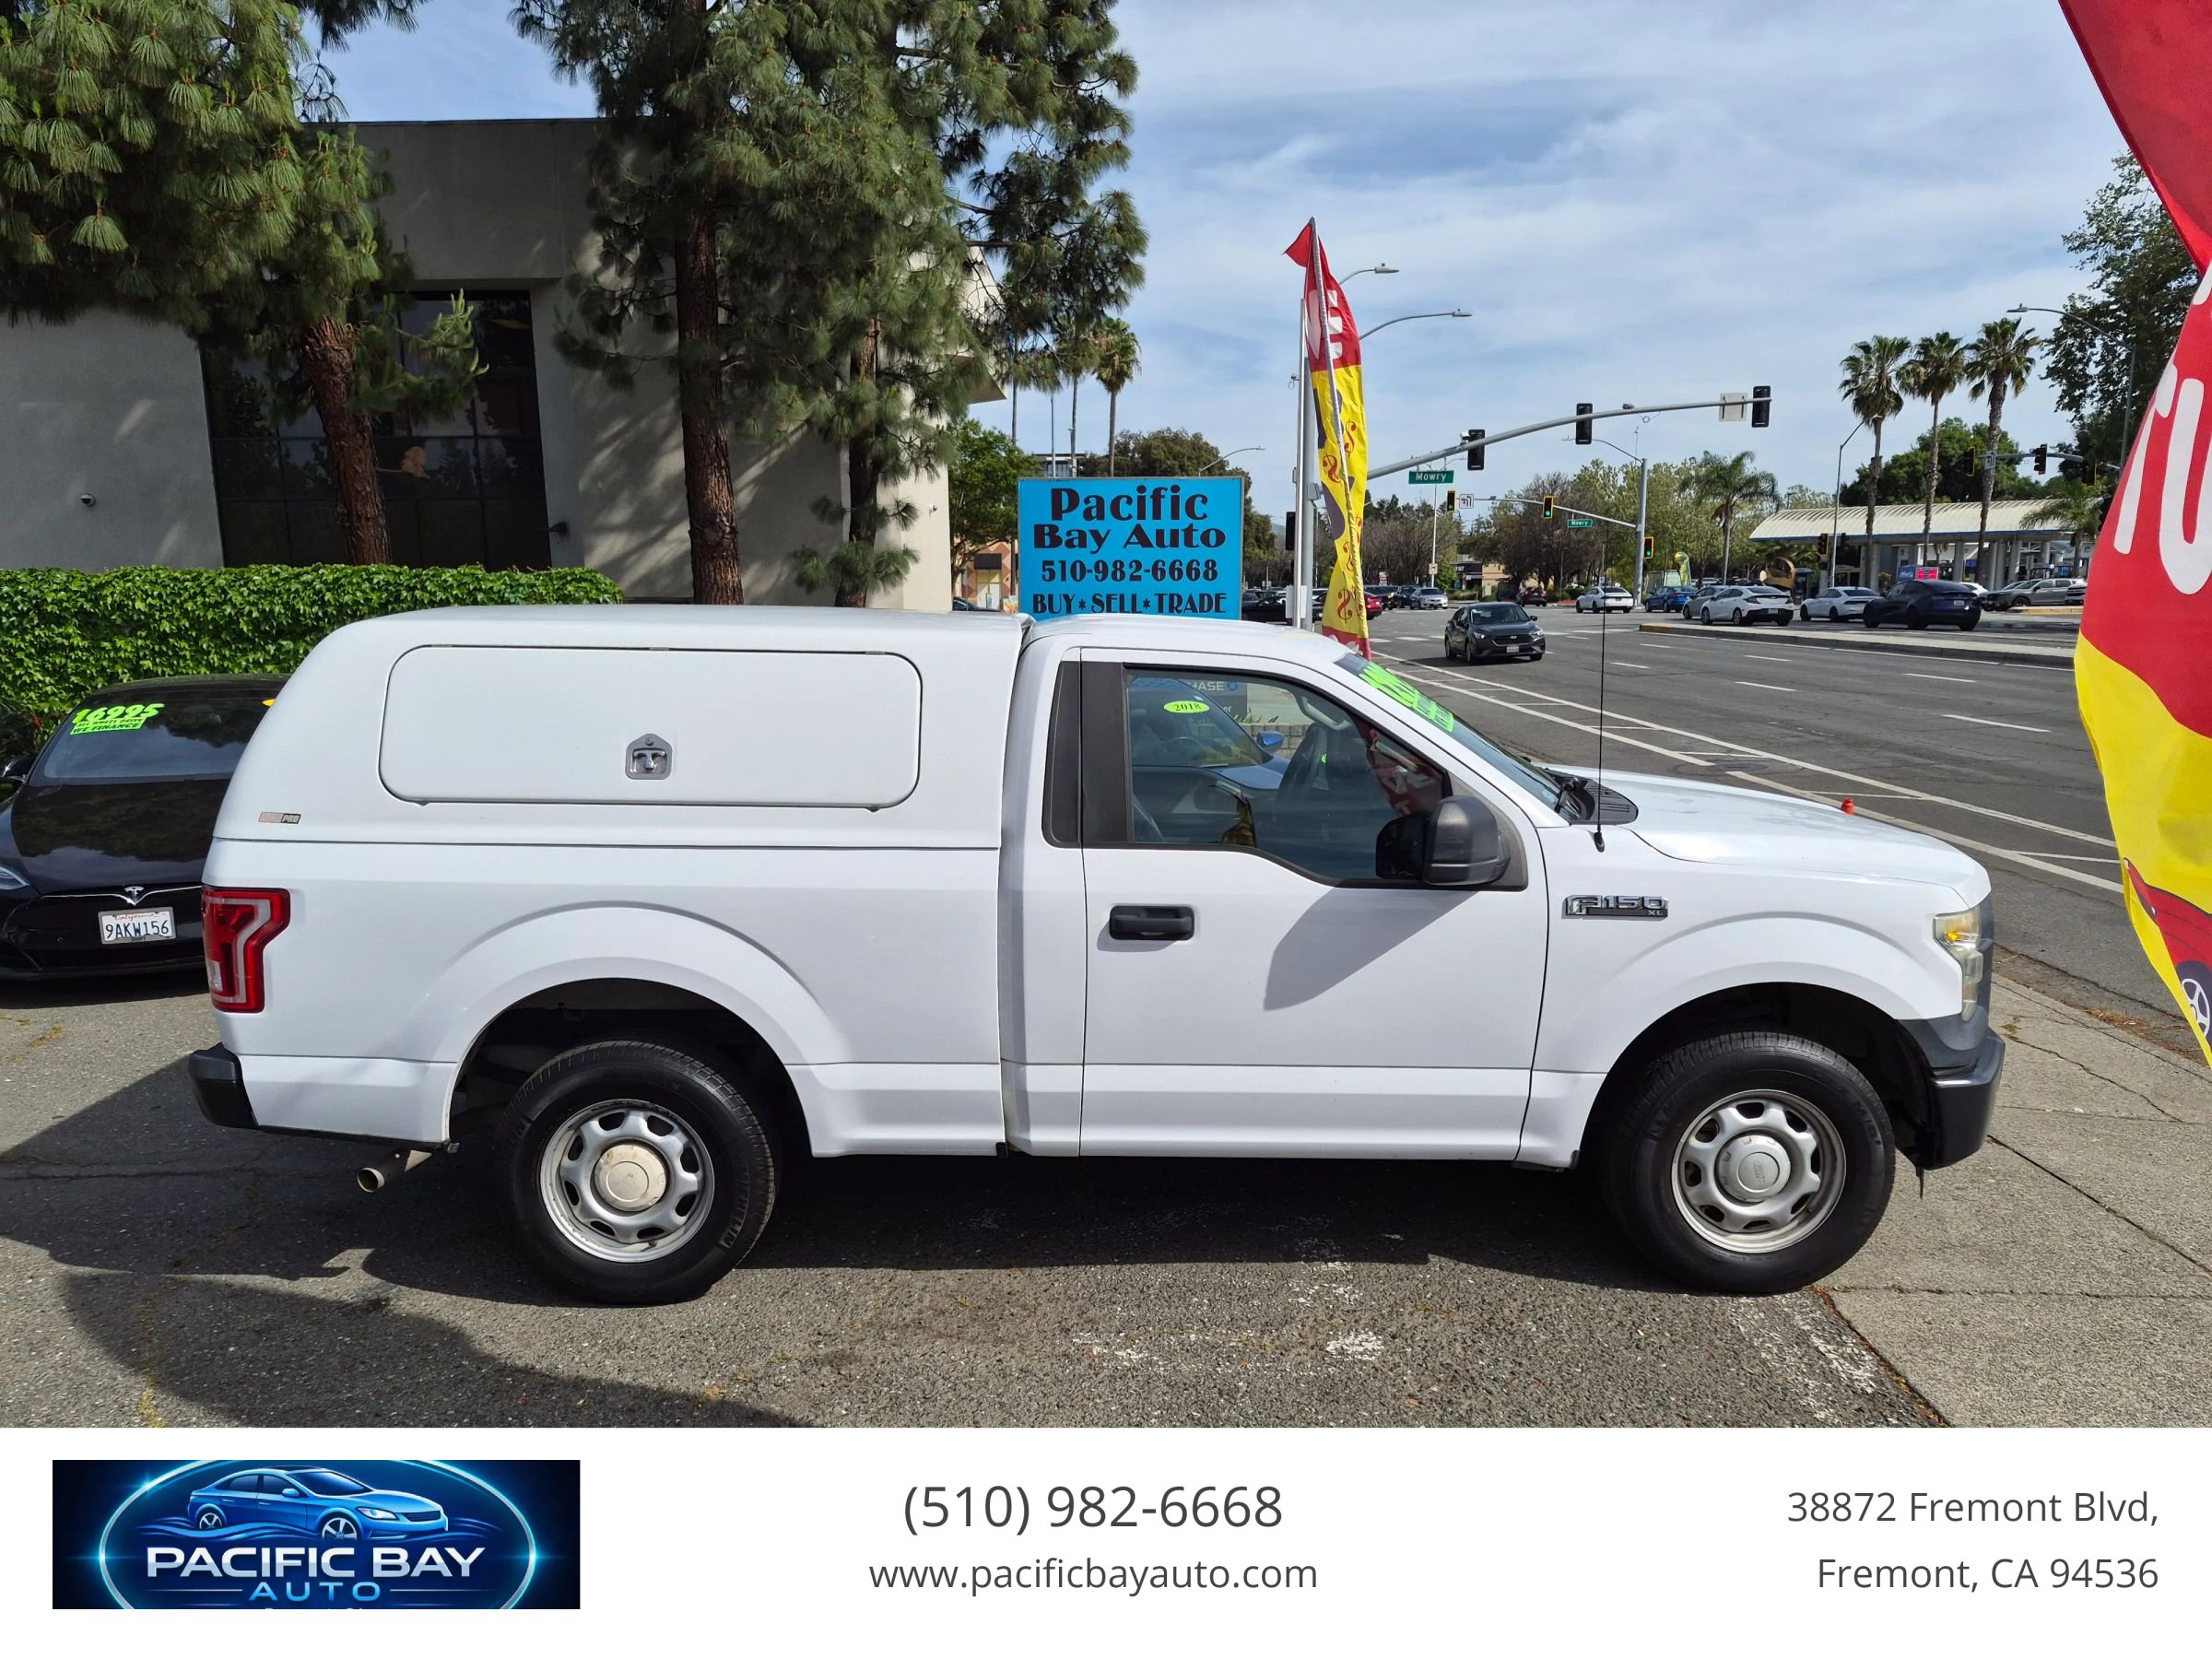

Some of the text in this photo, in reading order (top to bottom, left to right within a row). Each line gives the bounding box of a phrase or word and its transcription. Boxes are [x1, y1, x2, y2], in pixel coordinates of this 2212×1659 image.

[1416, 472, 1446, 482] Mowry
[1051, 484, 1208, 521] Pacific
[1033, 524, 1226, 554] Bay Auto
[1041, 559, 1218, 582] 510-982-6668
[1033, 593, 1227, 614] BUY SELL TRADE
[72, 703, 164, 724] 16995
[1173, 703, 1202, 712] 2018
[91, 723, 140, 731] FINANCE
[105, 920, 170, 939] 9AKW156
